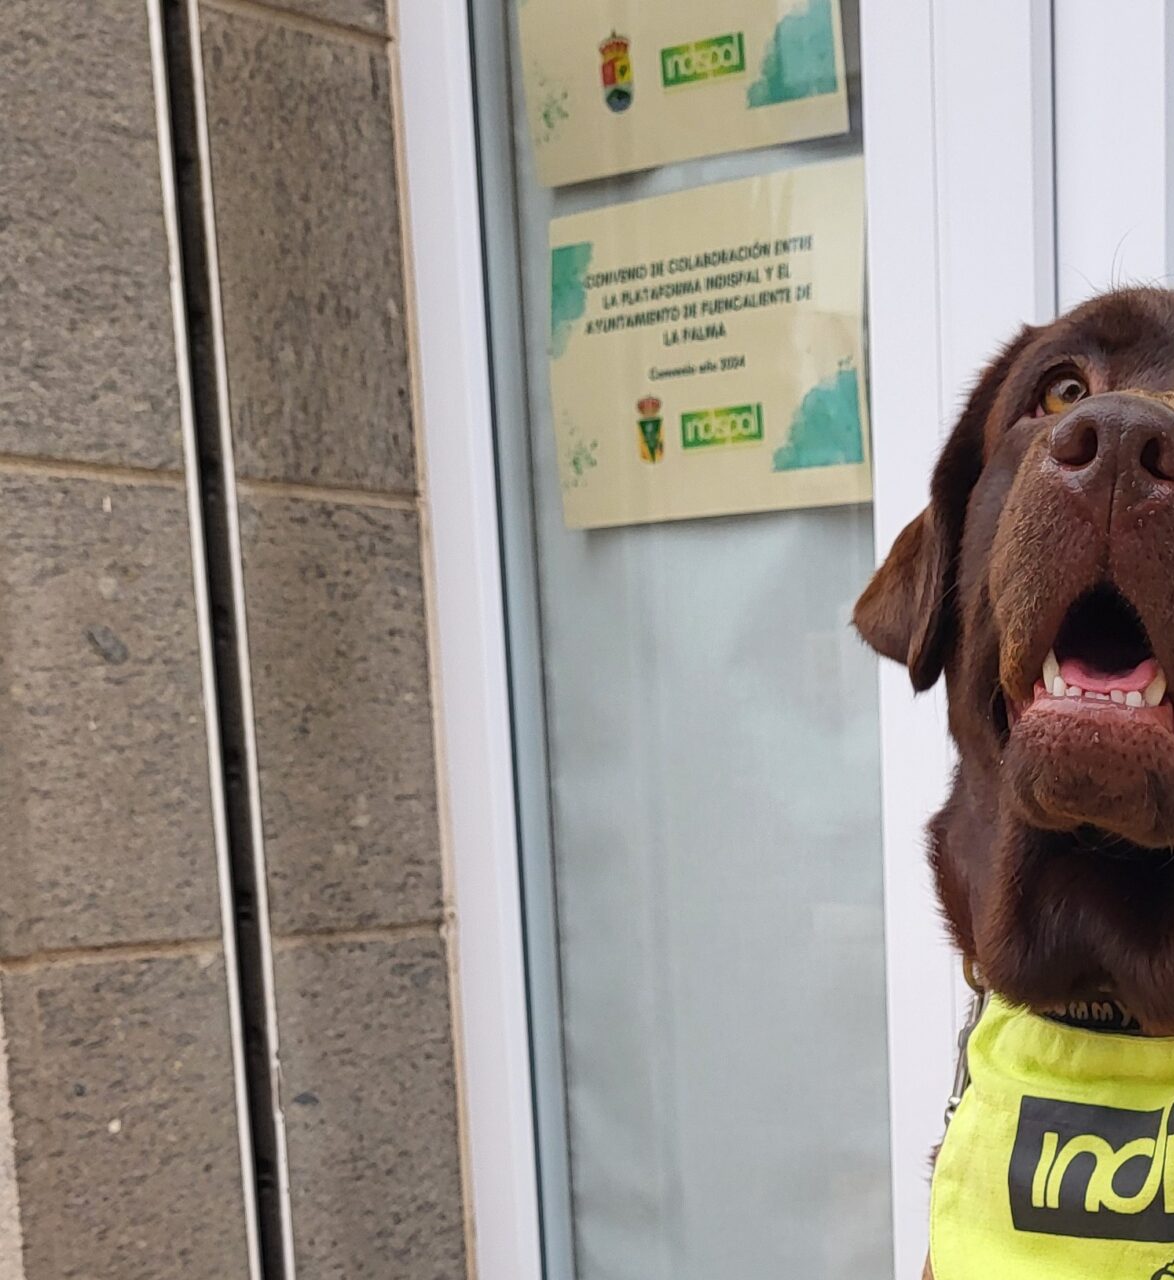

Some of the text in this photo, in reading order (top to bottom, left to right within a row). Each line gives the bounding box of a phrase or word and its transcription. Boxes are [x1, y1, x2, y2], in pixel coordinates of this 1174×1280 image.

[584, 264, 648, 290] CONVENIO
[651, 259, 665, 278] DE
[668, 241, 771, 272] COLABORACIÓN
[602, 262, 791, 310] LA PLATAFORMA INDISPAL Y EL
[586, 283, 812, 335] AYUNTAMIENTO DE FUENCALIENTE DE
[663, 322, 727, 346] LA PALMA
